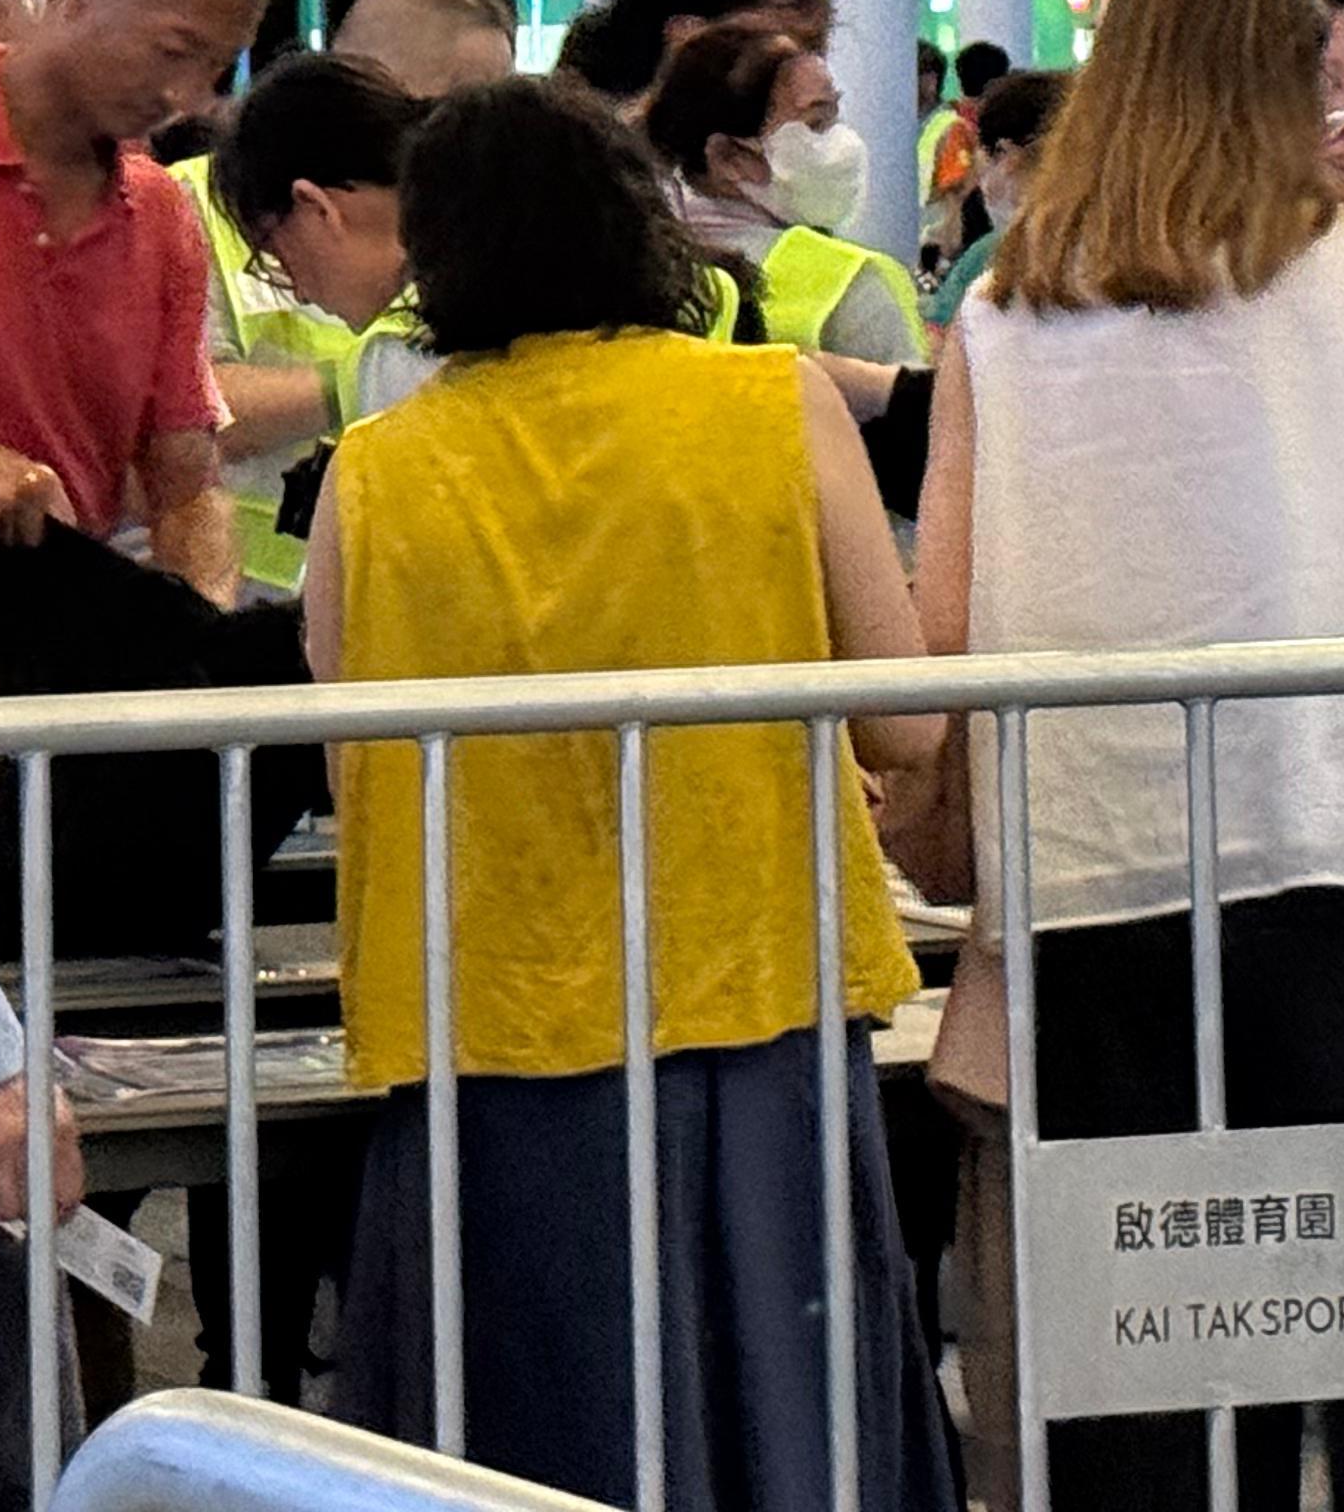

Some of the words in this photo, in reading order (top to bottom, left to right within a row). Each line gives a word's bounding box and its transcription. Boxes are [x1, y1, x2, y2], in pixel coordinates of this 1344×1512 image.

[1114, 1193, 1335, 1252] 啟德體育園
[1115, 1305, 1170, 1346] KAI
[1186, 1299, 1255, 1339] TAK
